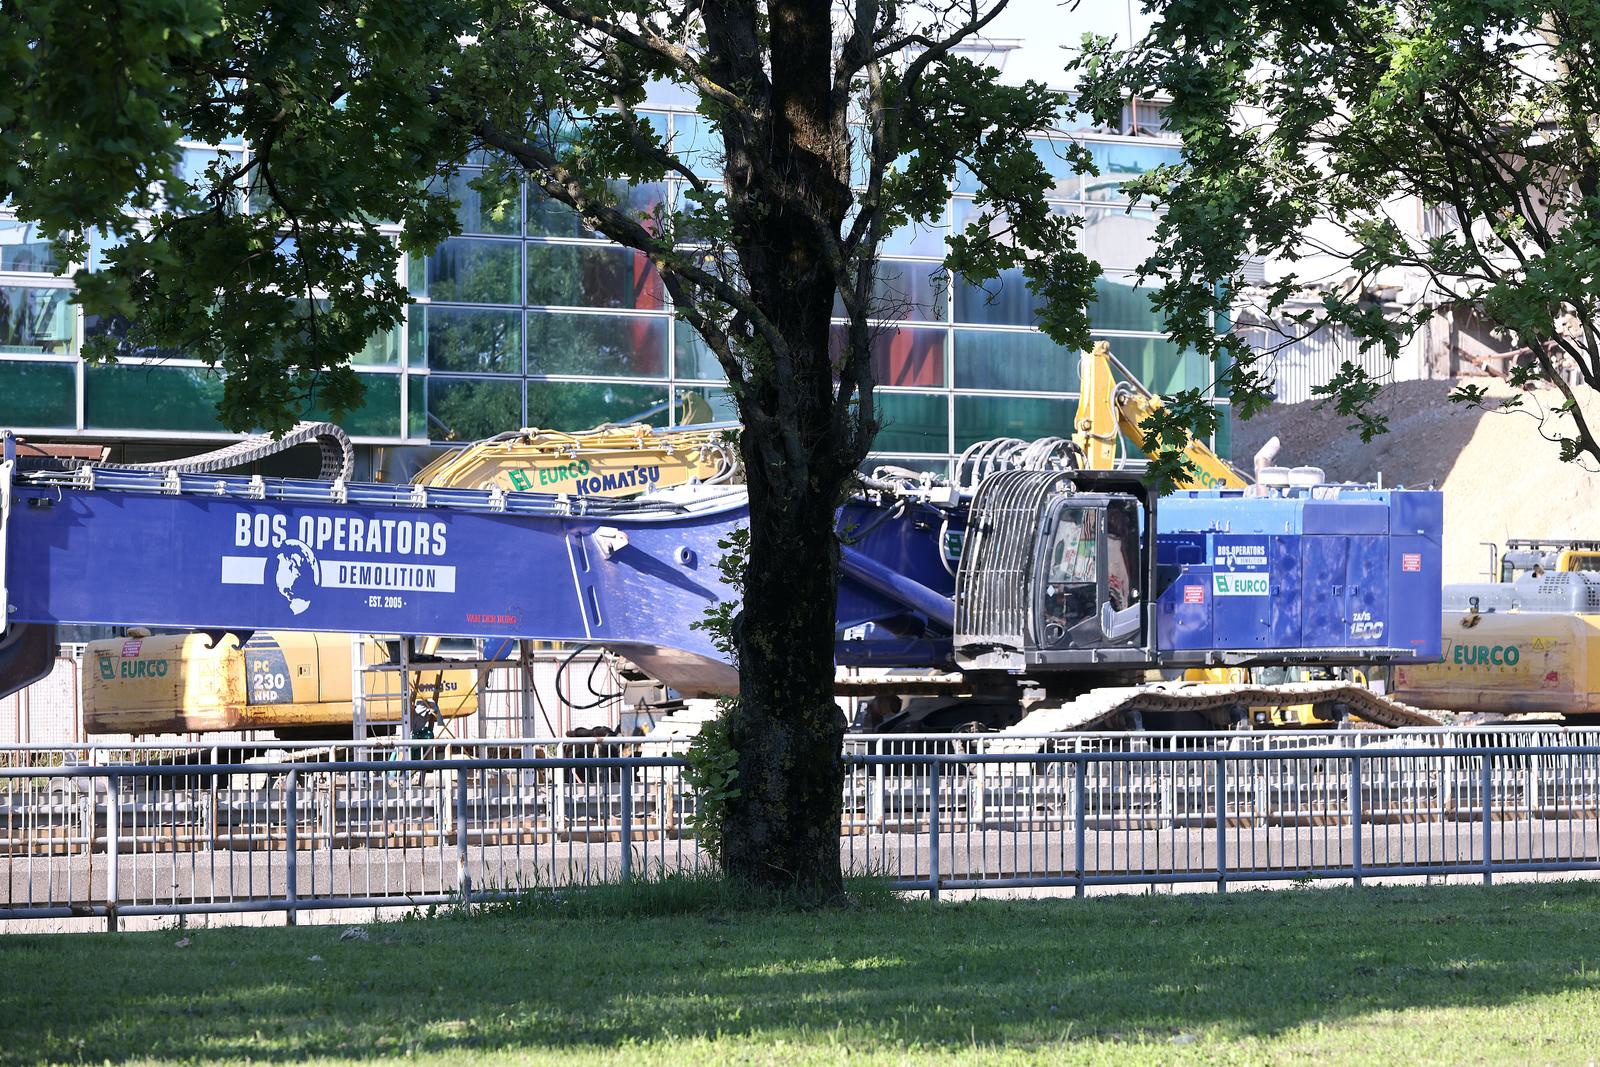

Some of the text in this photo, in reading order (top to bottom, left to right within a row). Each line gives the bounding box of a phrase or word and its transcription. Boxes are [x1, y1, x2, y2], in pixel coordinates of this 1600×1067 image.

[539, 459, 590, 486] EURCO
[575, 465, 660, 496] KOMATSU
[235, 512, 447, 556] BOS OPERATORS
[339, 565, 436, 588] DEMOLITION
[1234, 579, 1268, 593] EURCO
[368, 595, 402, 609] EST. 2005
[1453, 645, 1520, 666] EURCO
[121, 659, 168, 679] EURCO
[253, 660, 270, 673] PC
[253, 673, 285, 690] 230
